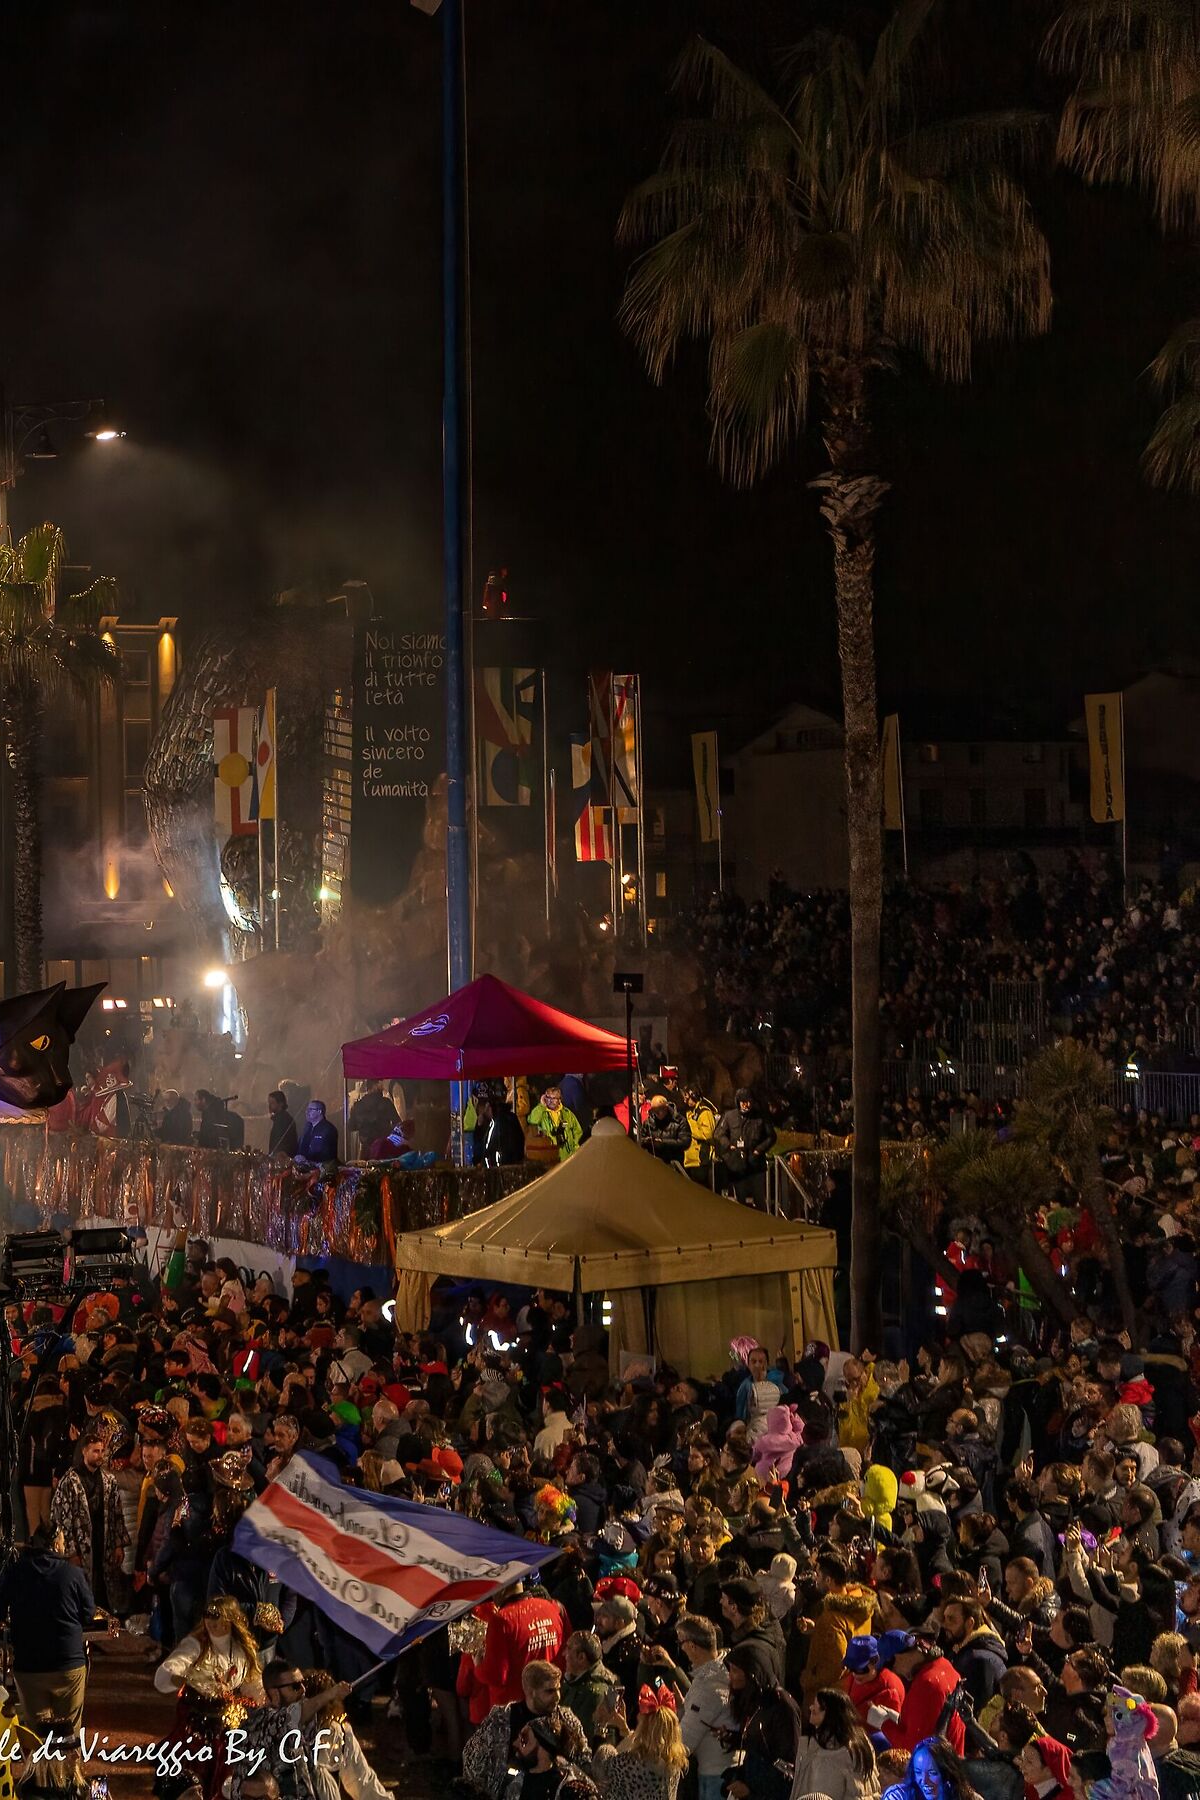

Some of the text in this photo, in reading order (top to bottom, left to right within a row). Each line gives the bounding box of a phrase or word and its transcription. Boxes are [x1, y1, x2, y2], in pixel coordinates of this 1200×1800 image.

[366, 631, 395, 651] Noi
[365, 651, 443, 668] il trionfo
[364, 670, 436, 687] di tutte
[365, 725, 430, 742] il volto
[362, 745, 425, 760] sincero
[363, 763, 383, 779] de
[362, 781, 429, 798] l'umanità
